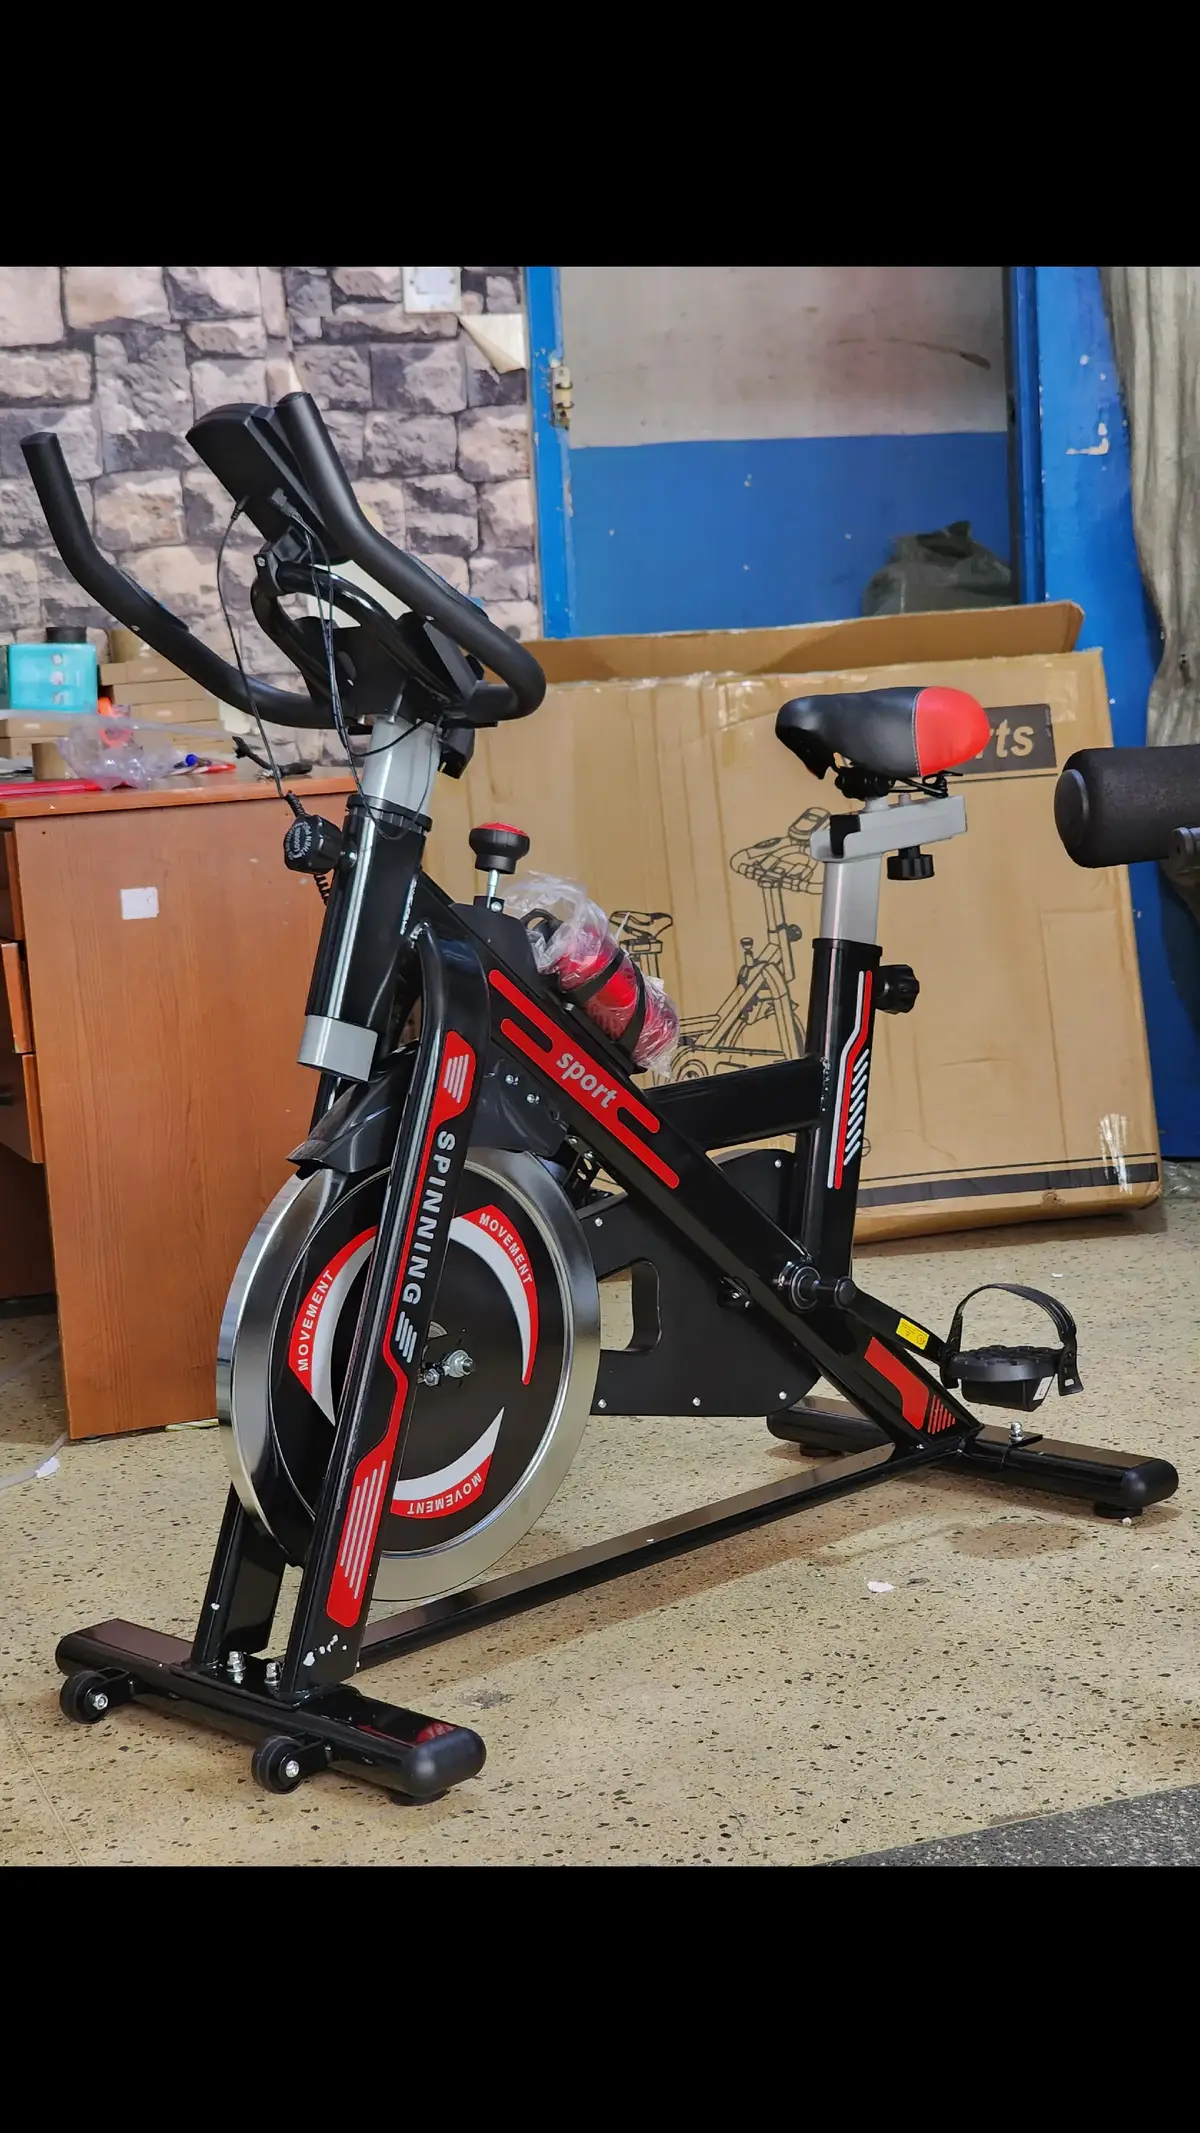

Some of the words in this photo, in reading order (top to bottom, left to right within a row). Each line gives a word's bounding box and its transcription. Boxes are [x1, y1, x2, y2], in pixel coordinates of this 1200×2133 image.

[556, 1052, 617, 1108] sport
[402, 1130, 455, 1305] SPINNING
[479, 1212, 533, 1284] MOVEMENT
[298, 1269, 335, 1372] MOVEMENT
[407, 1472, 482, 1515] MOVEMENT
